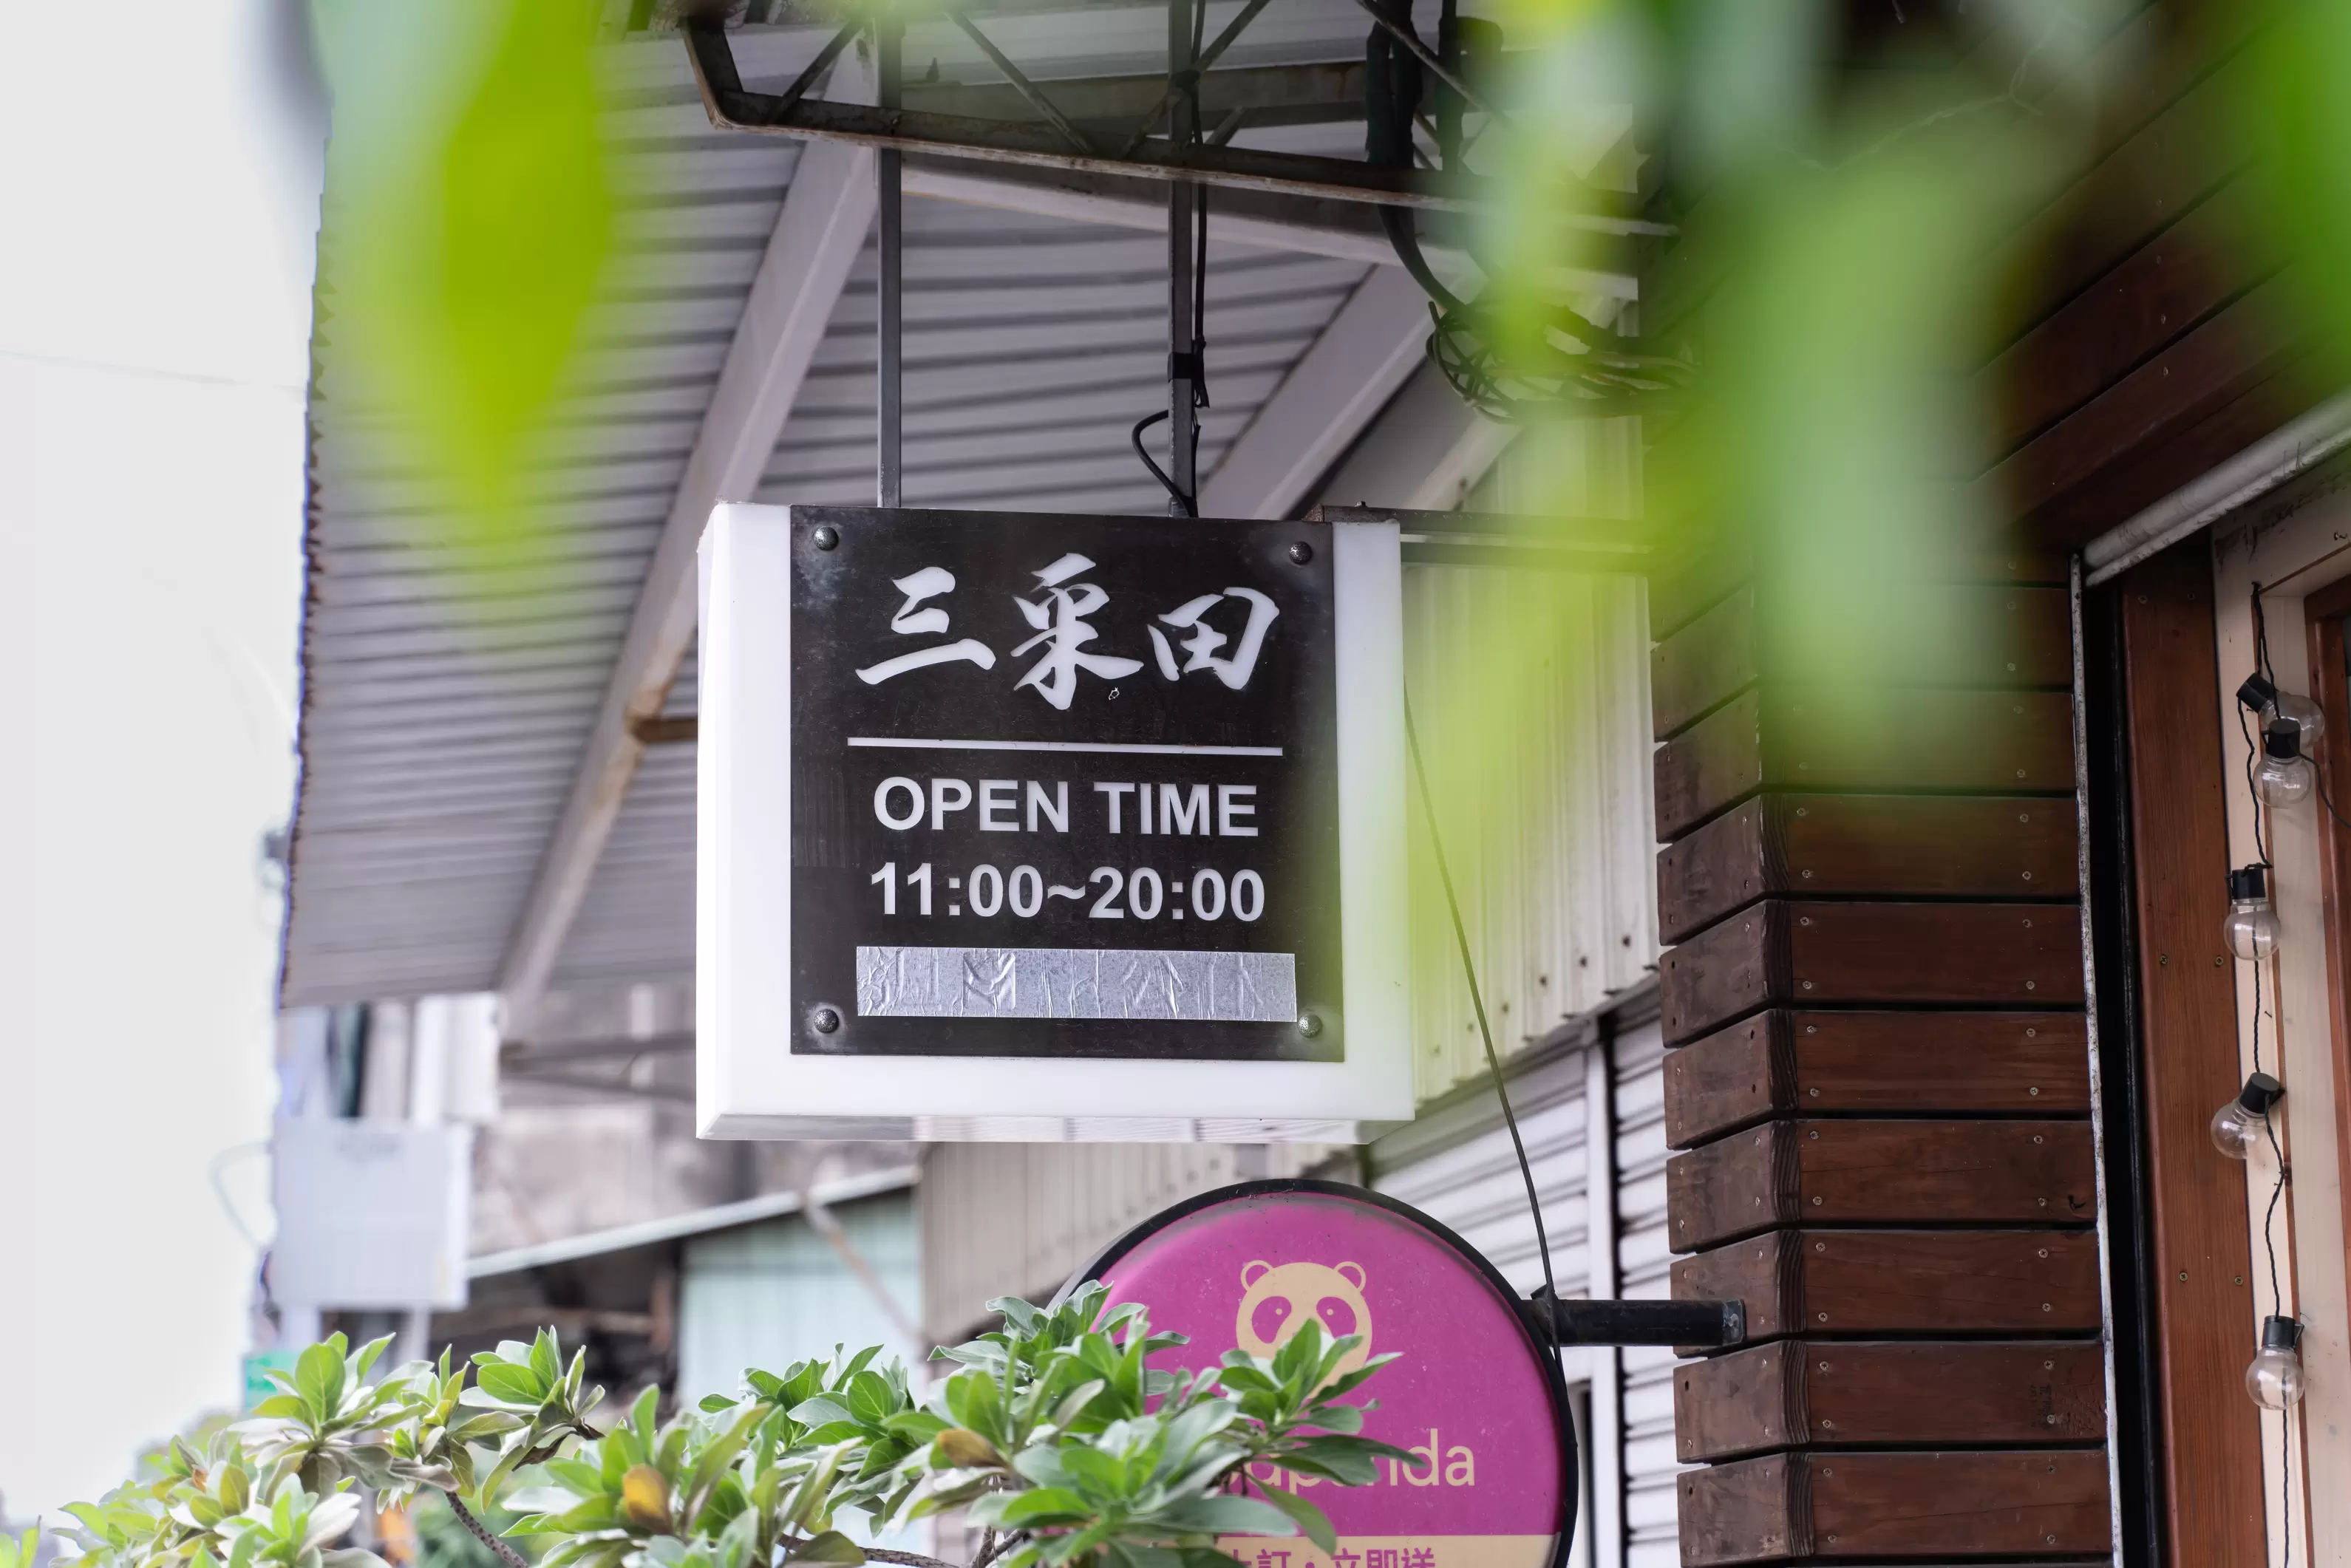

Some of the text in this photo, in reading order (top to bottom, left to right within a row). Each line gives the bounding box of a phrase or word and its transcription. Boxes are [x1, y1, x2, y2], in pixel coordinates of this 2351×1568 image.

[874, 776, 1259, 836] OPEN TIME
[871, 862, 1265, 922] 11:00~20:00
